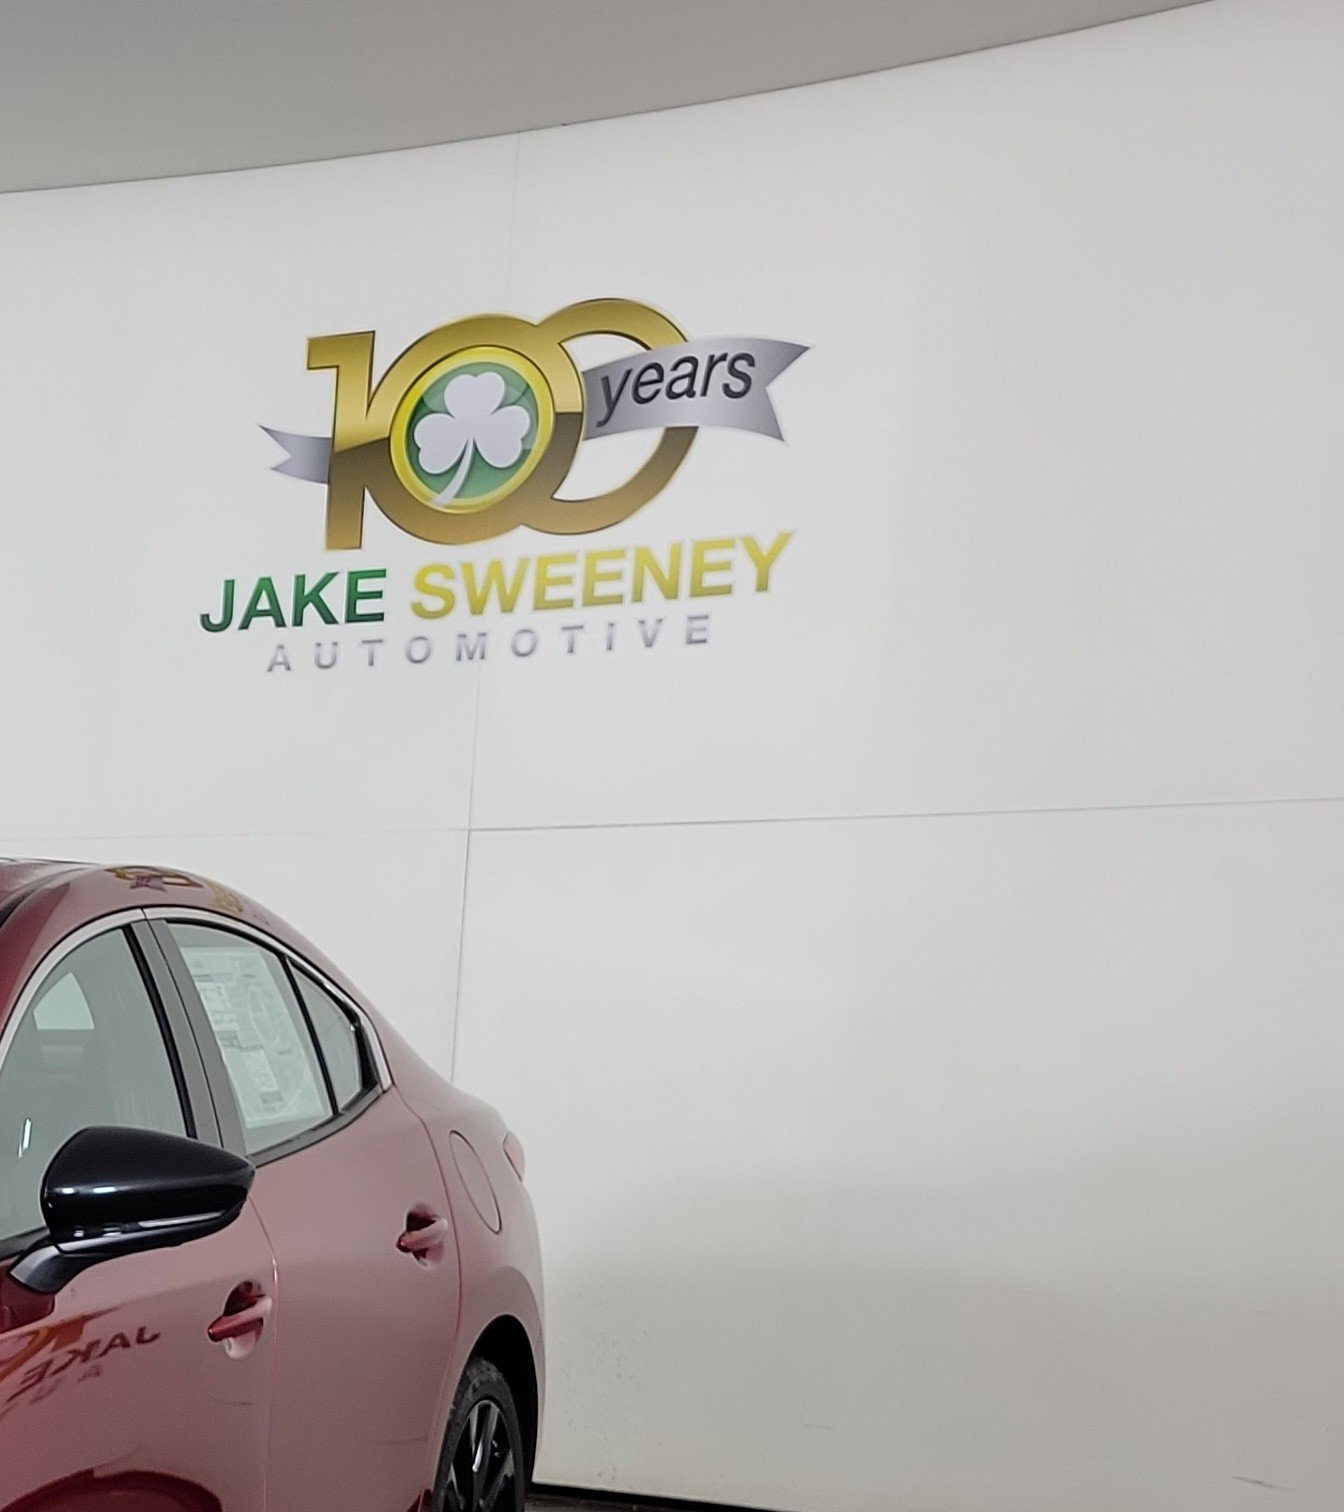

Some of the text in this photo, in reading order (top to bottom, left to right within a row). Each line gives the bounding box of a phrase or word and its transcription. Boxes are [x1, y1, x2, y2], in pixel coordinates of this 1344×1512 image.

[306, 297, 756, 551] 100 years
[199, 532, 795, 633] JAKE SWEENEY
[266, 615, 711, 673] AUTOMOTIVE
